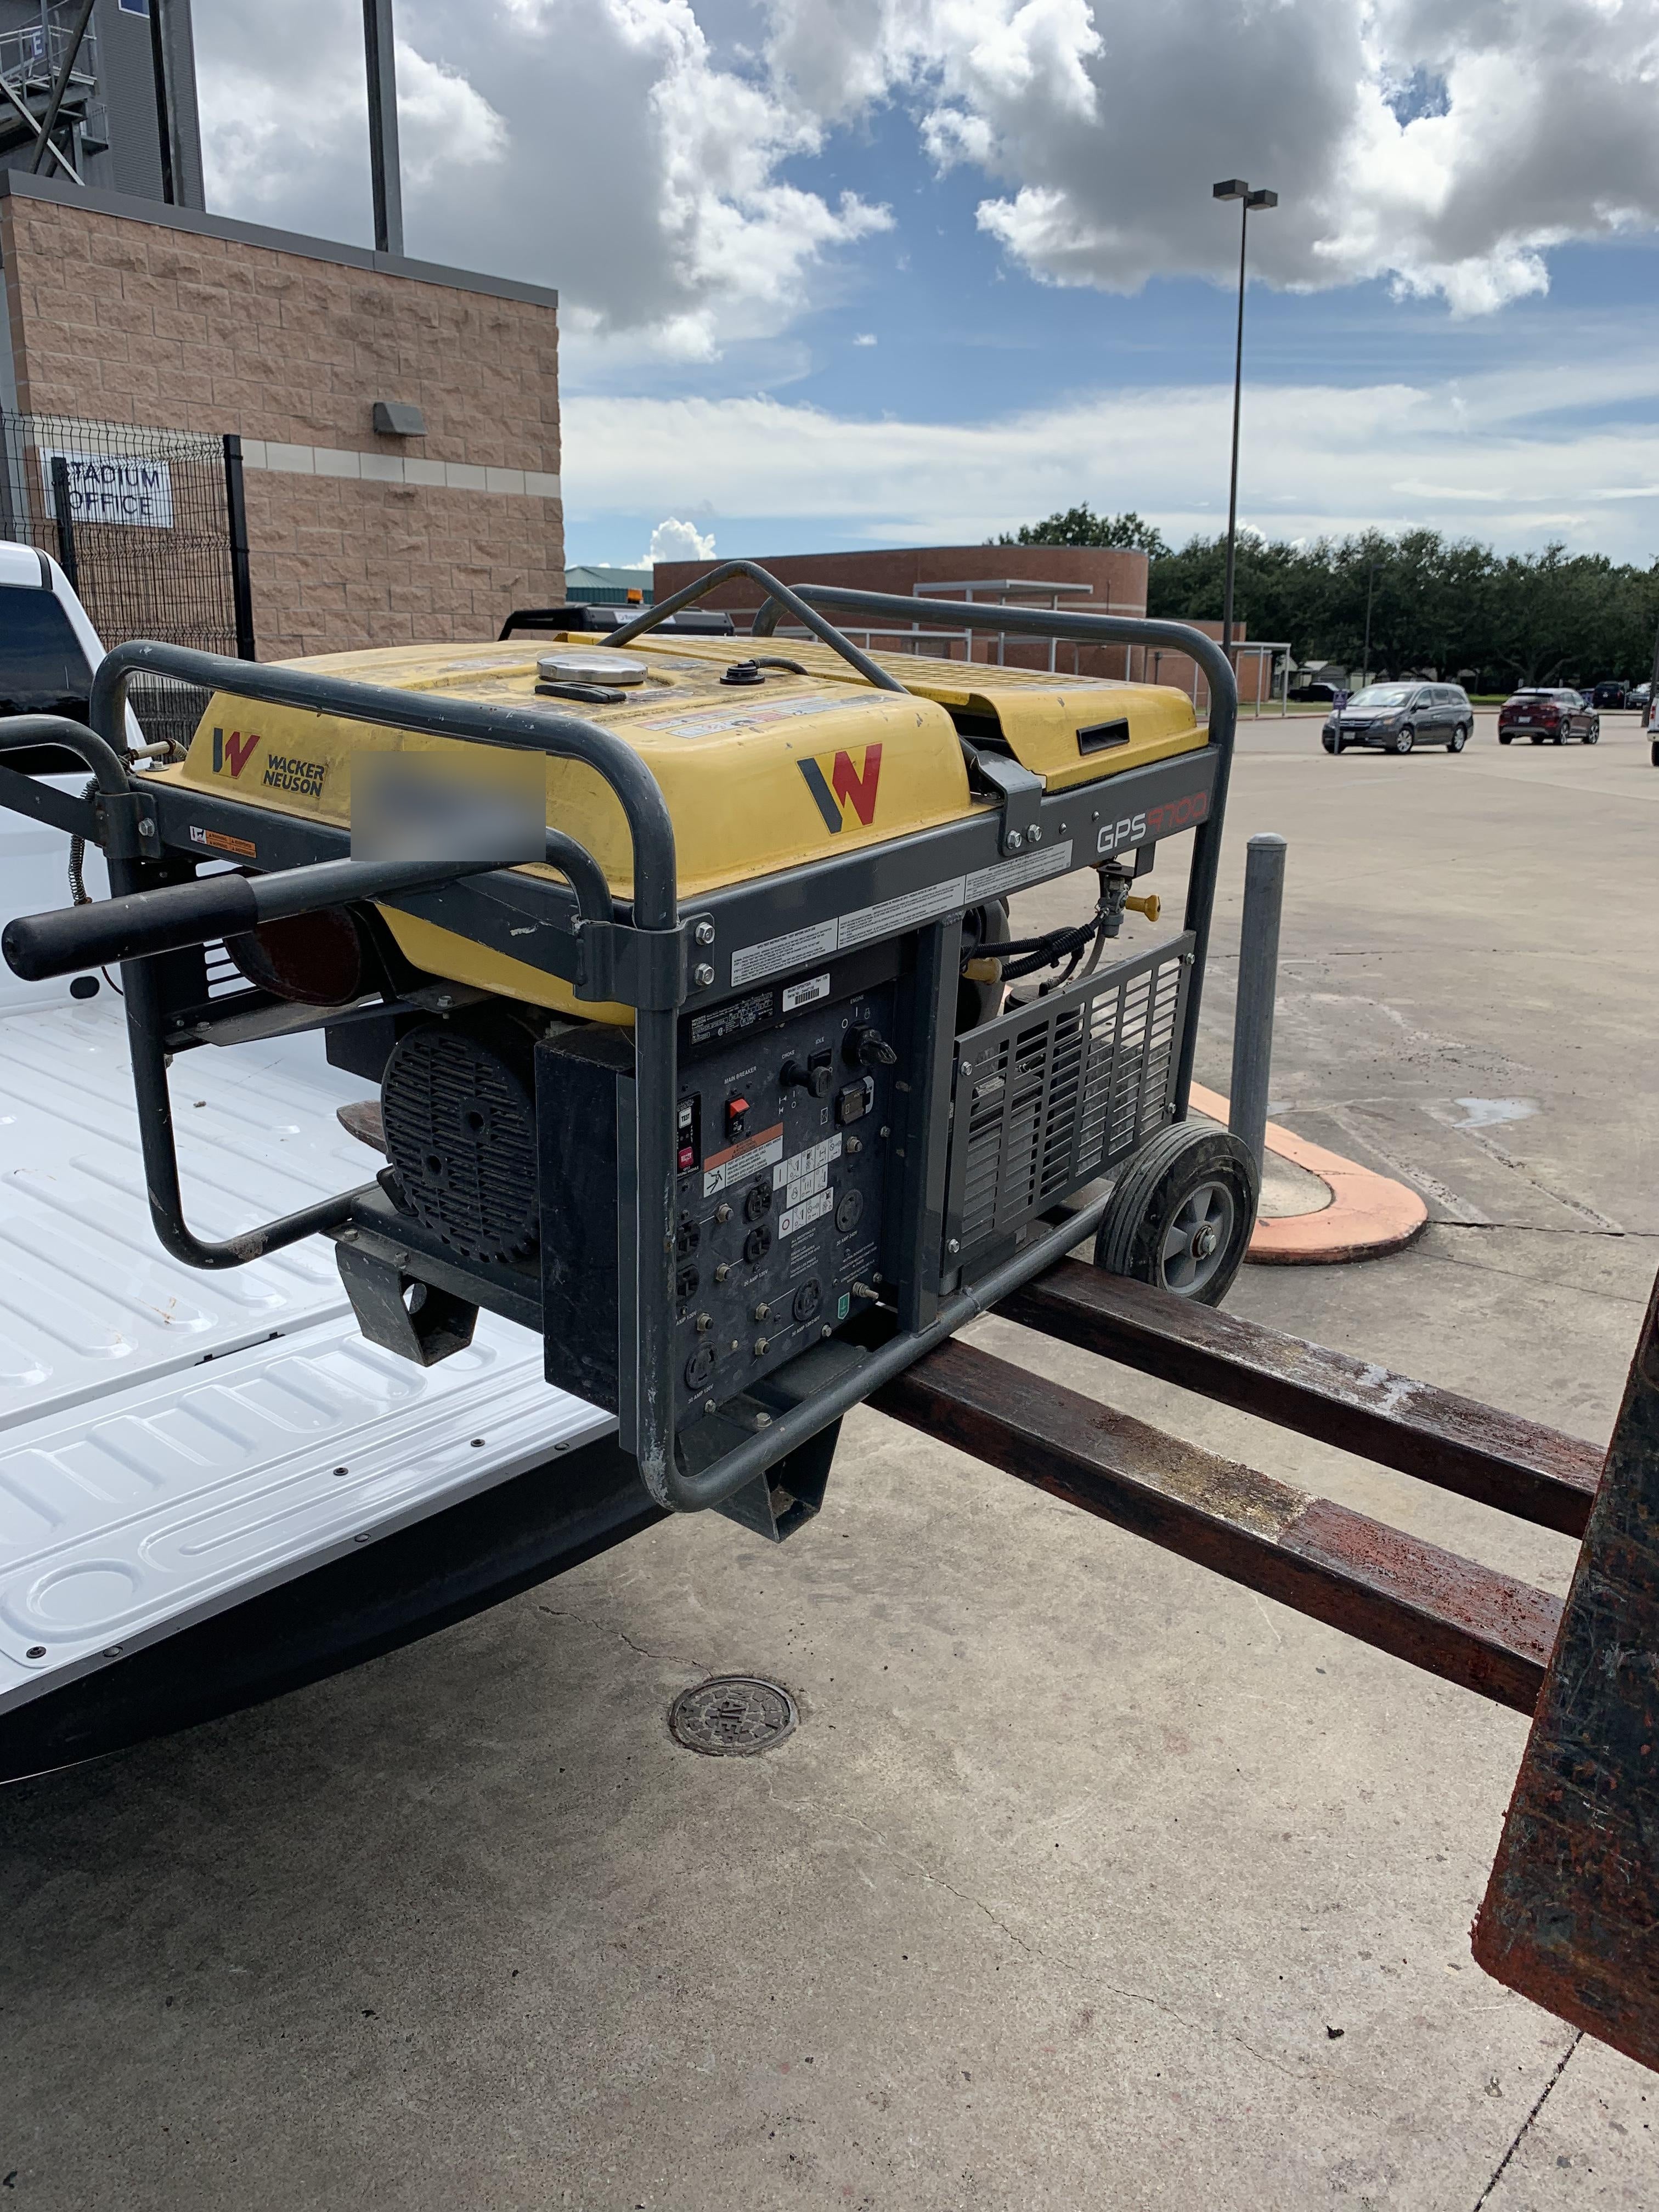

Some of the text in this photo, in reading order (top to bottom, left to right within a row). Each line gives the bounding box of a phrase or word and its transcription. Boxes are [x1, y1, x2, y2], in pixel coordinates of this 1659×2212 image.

[65, 462, 159, 489] TADIUM
[69, 490, 153, 515] OFFICE
[268, 754, 325, 781] WACKER
[263, 770, 323, 797] NEUSON
[815, 1037, 825, 1045] IDLE
[782, 1049, 795, 1059] CHOKE
[724, 1066, 757, 1085] MAIN BREAKER
[681, 1114, 690, 1122] TEST
[749, 1274, 758, 1284] AMP
[676, 1310, 697, 1327] AMP 120V
[693, 1390, 703, 1401] AMP
